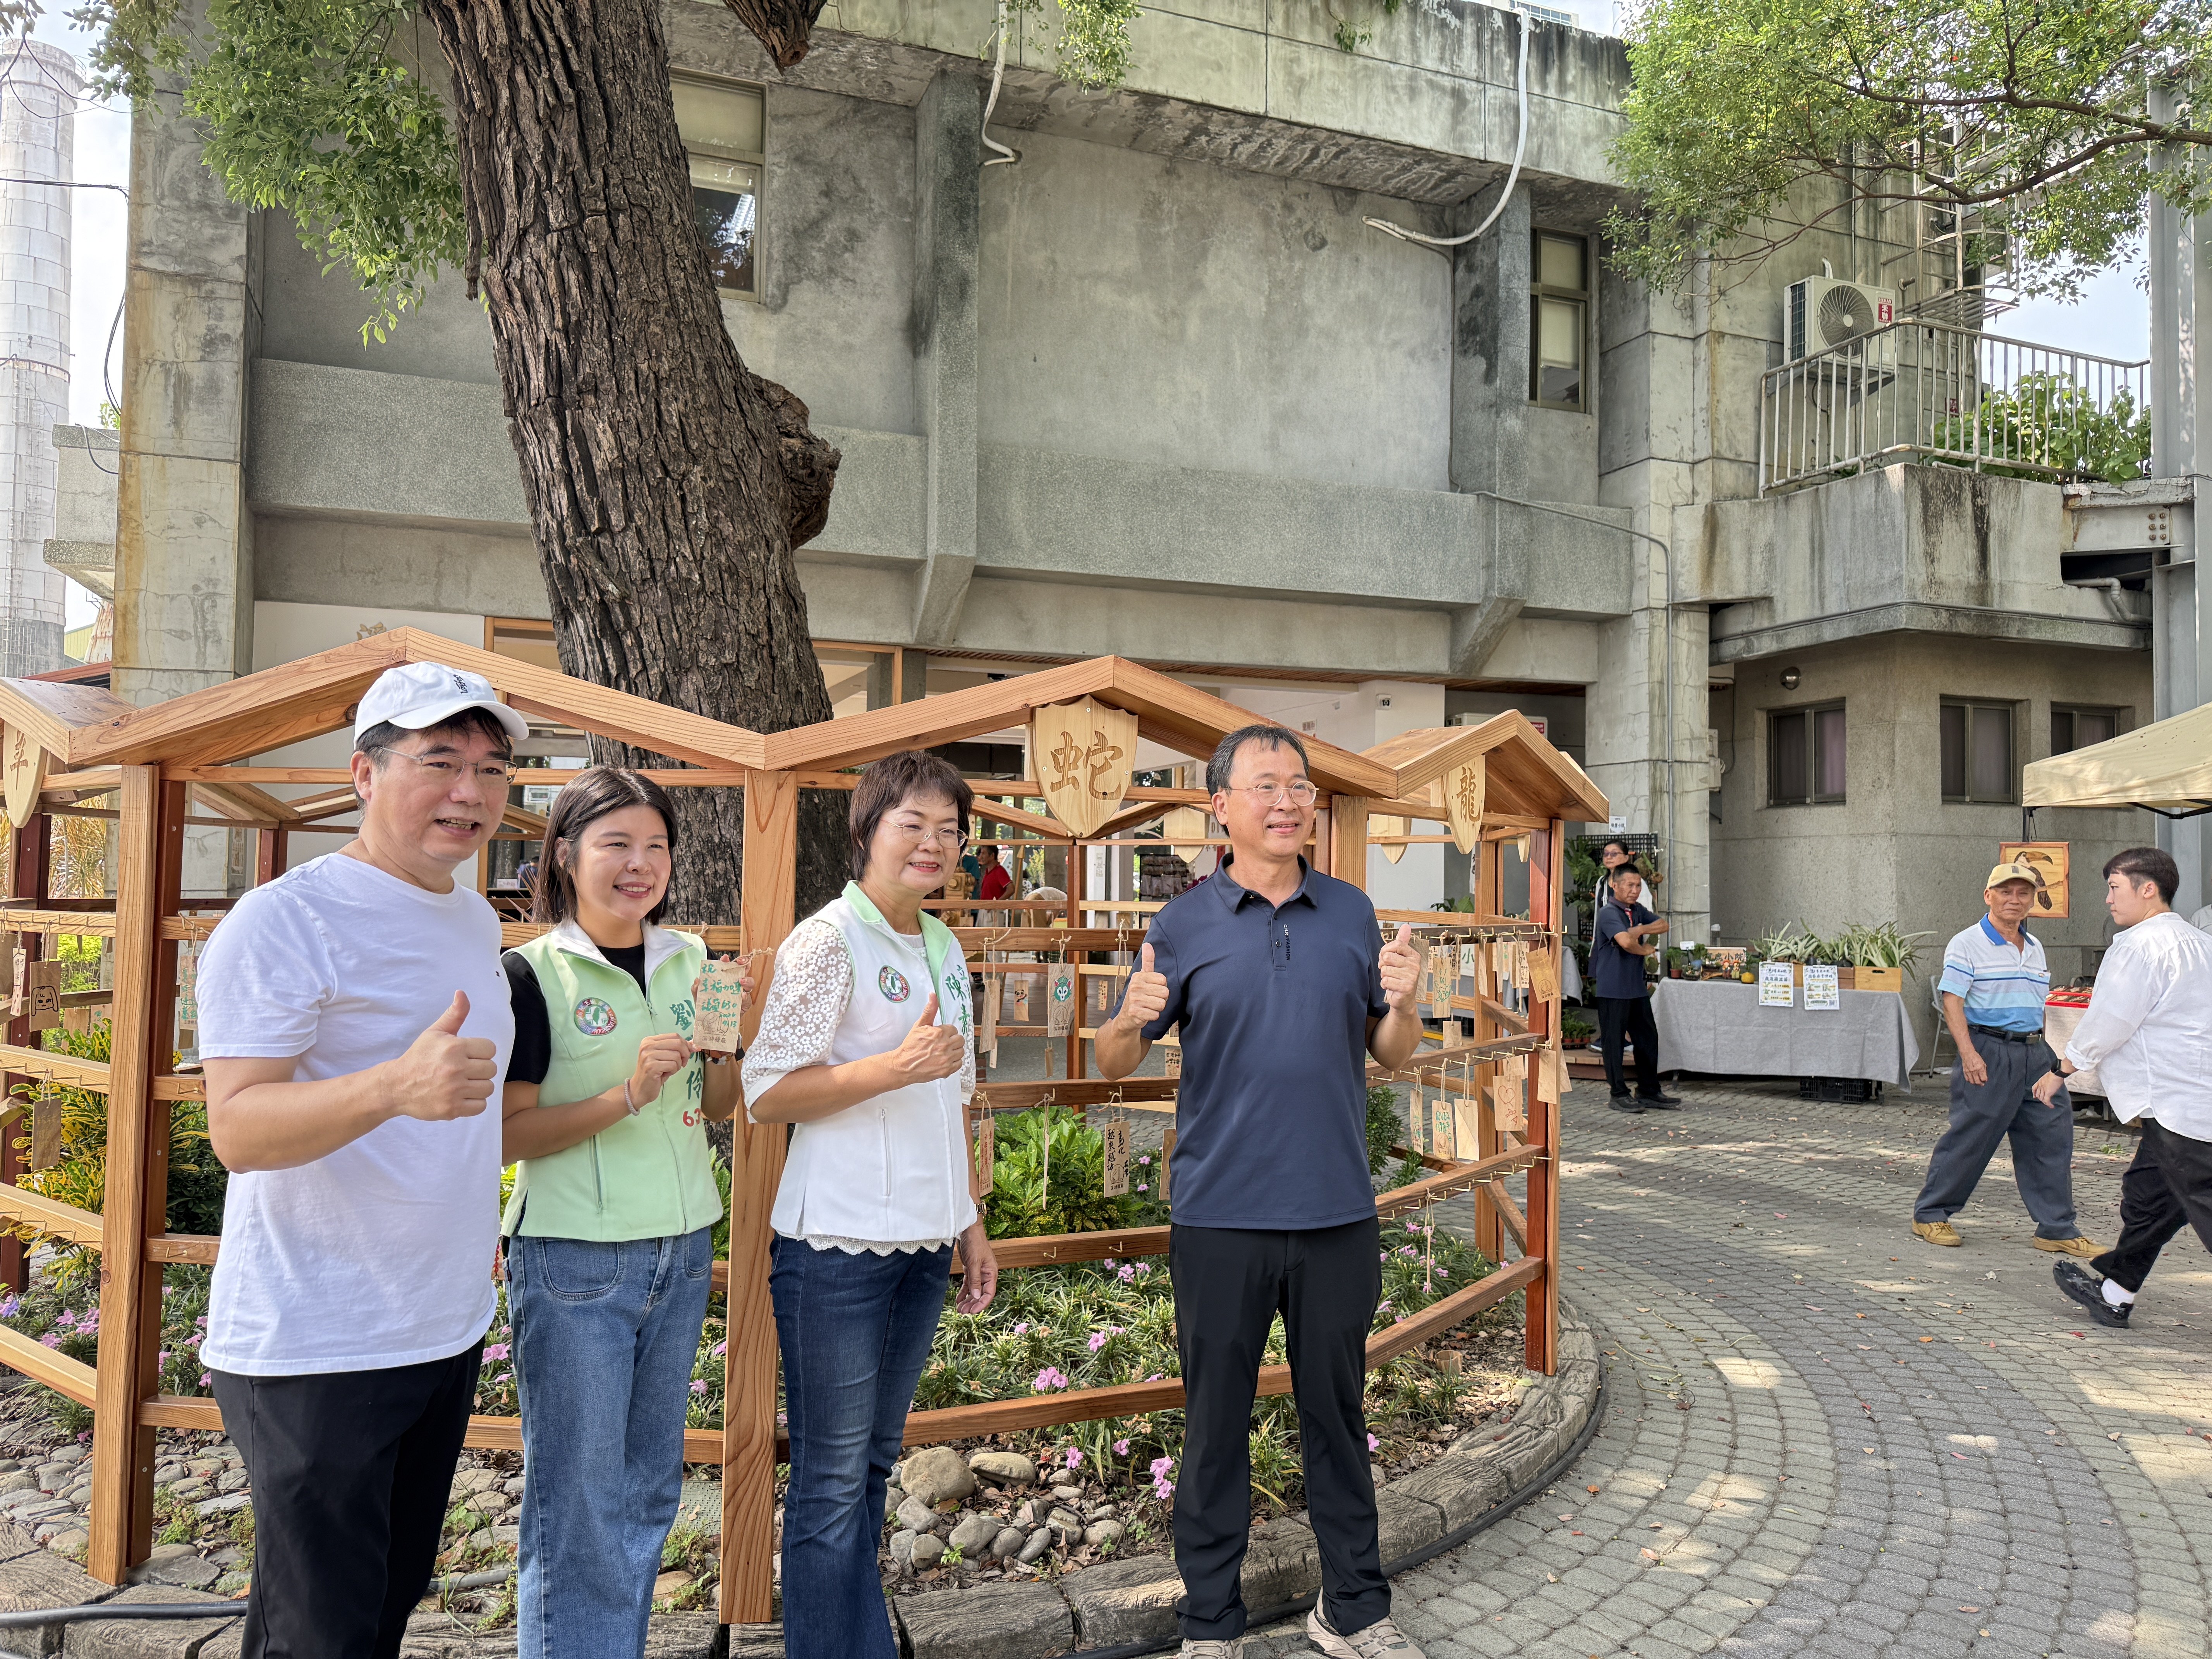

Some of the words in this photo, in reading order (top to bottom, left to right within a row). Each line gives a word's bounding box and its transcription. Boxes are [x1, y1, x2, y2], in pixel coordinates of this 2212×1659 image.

[1050, 730, 1123, 800] 蛇
[1456, 766, 1480, 823] 龍
[701, 963, 716, 974] 祝
